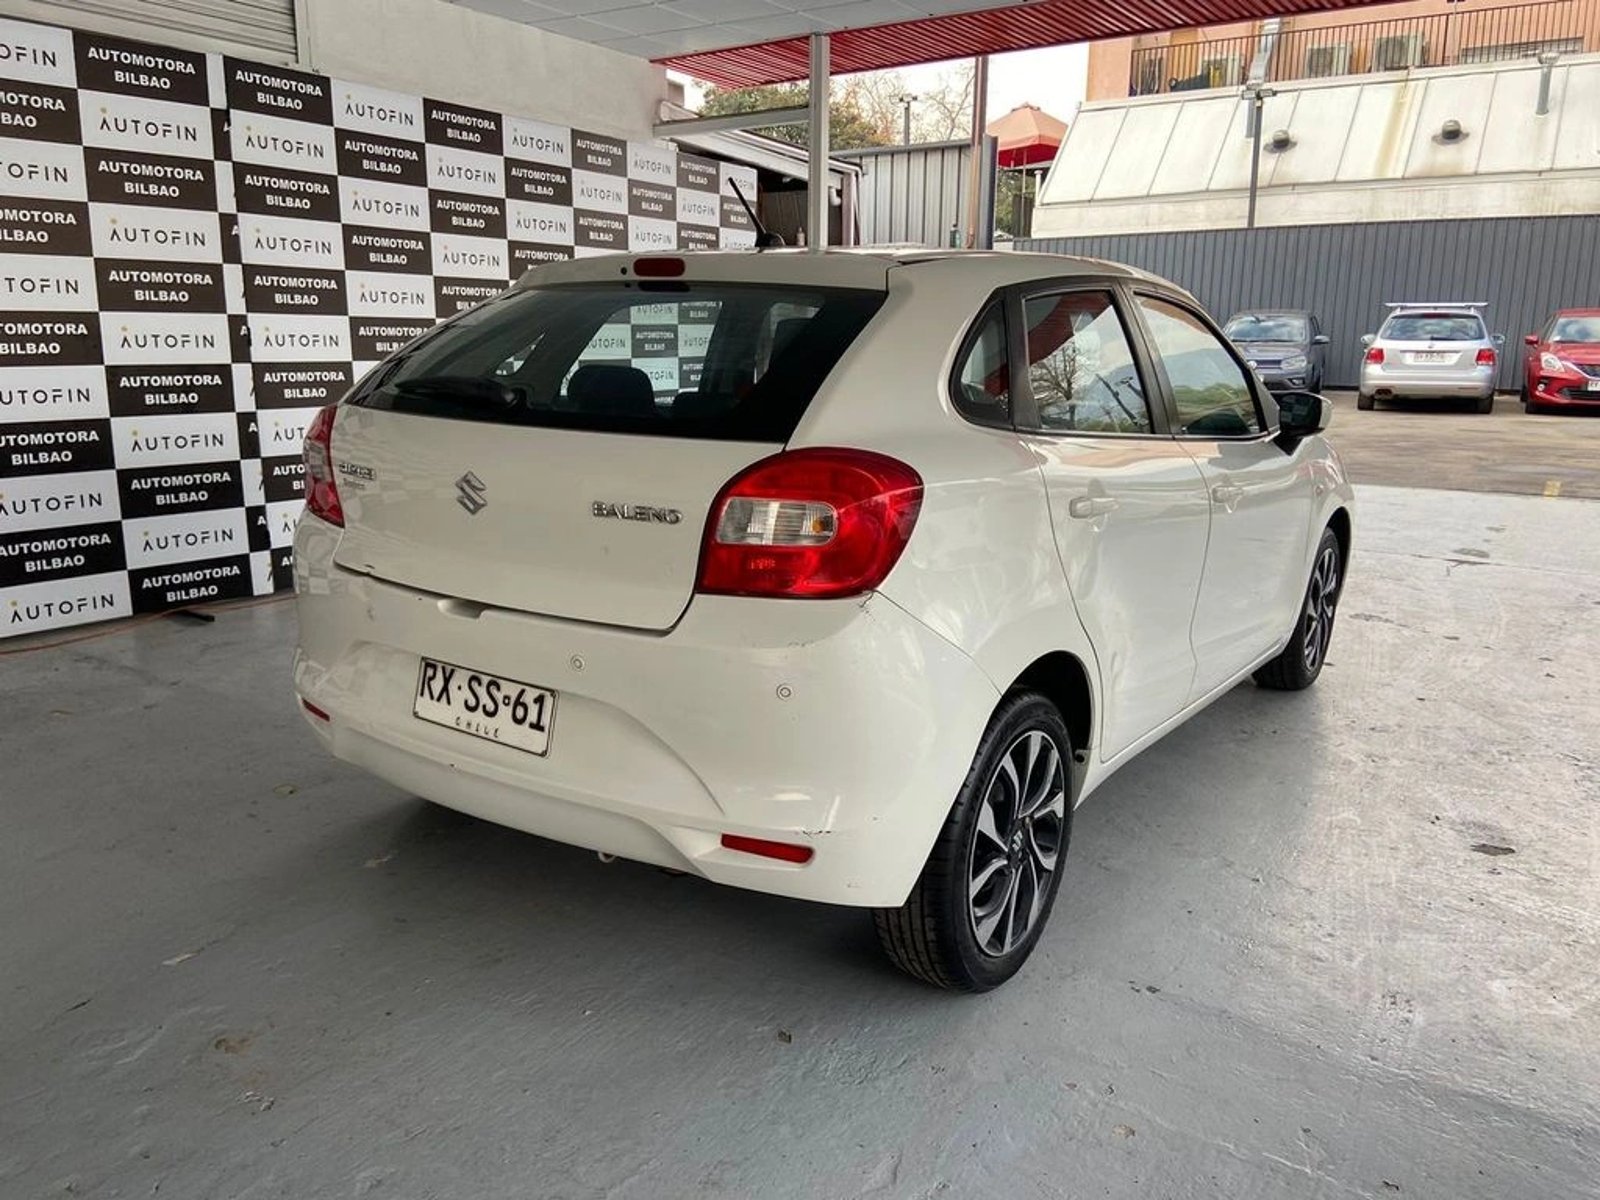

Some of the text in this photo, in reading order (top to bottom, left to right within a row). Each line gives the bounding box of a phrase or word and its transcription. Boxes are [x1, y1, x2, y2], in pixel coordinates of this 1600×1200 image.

[88, 47, 195, 74] AUTOMOTORA
[114, 71, 170, 89] BILBAO
[236, 70, 322, 96] AUTOMOTORA
[257, 93, 302, 110] BILBAO
[1, 112, 37, 127] BAO
[345, 104, 413, 125] AUTOFIN
[431, 110, 496, 131] AUTOMOTORA
[100, 117, 197, 141] AUTOFIN
[446, 129, 481, 143] BILBAO
[246, 136, 324, 158] AUTOFIN
[345, 140, 418, 161] AUTOMOTORA
[512, 135, 563, 153] AUTOFIN
[576, 139, 622, 156] AUTOMOTORA
[363, 159, 401, 174] BILBAO
[587, 155, 611, 167] BILBAO
[634, 159, 672, 175] AUTOFIN
[0, 162, 68, 182] OFIN
[98, 160, 204, 181] AUTOMOTORA
[437, 166, 496, 184] AUTOFIN
[511, 167, 567, 184] AUTOMOTORA
[124, 182, 179, 198] BILBAO
[245, 175, 330, 195] AUTOMOTORA
[524, 184, 554, 196] BILBAO
[266, 195, 310, 209] BILBAO
[580, 187, 622, 202] AUTOFIN
[632, 188, 673, 201] AUTOMOTORA
[353, 199, 419, 217] AUTOFIN
[437, 200, 500, 216] AUTOMOTORA
[641, 201, 663, 212] BILBAO
[452, 216, 485, 229] BILBAO
[516, 216, 566, 233] AUTOFIN
[579, 217, 624, 231] AUTOMOTORA
[110, 228, 205, 246] AUTOFIN
[352, 235, 424, 250] AUTOMOTORA
[589, 231, 613, 242] BILBAO
[255, 238, 331, 254] AUTOFIN
[369, 253, 407, 265] BILBAO
[443, 252, 499, 267] AUTOFIN
[515, 250, 569, 261] AUTOMOTORA
[109, 270, 213, 285] AUTOMOTORA
[254, 275, 338, 290] AUTOMOTORA
[4, 278, 78, 294] TOFIN
[134, 290, 189, 302] BILBAO
[274, 294, 319, 306] BILBAO
[360, 292, 424, 304] AUTOFIN
[0, 342, 61, 354] BILBAO
[121, 334, 215, 348] AUTOFIN
[264, 335, 339, 348] AUTOFIN
[376, 341, 404, 352] BILB
[120, 374, 222, 388] AUTOMOTORA
[264, 372, 345, 383] AUTOMOTORA
[0, 388, 90, 405] UTOFIN
[145, 392, 198, 405] BILBAO
[284, 387, 326, 398] BILBAO
[132, 434, 224, 452] AUTOFIN
[11, 450, 72, 466] BILBAO
[131, 472, 231, 491] AUTOMOTORA
[0, 493, 102, 516] AUTOFIN
[156, 490, 208, 505] BILBAO
[592, 501, 683, 524] BALENO
[0, 533, 111, 557] AUTOMOTORA
[143, 529, 233, 551] AUTOFIN
[25, 555, 85, 573] BILBAO
[141, 565, 240, 589] AUTOMOTORA
[166, 585, 218, 602] BILBAO
[11, 594, 115, 624] AUTOFIN
[455, 716, 499, 739] CHILE
